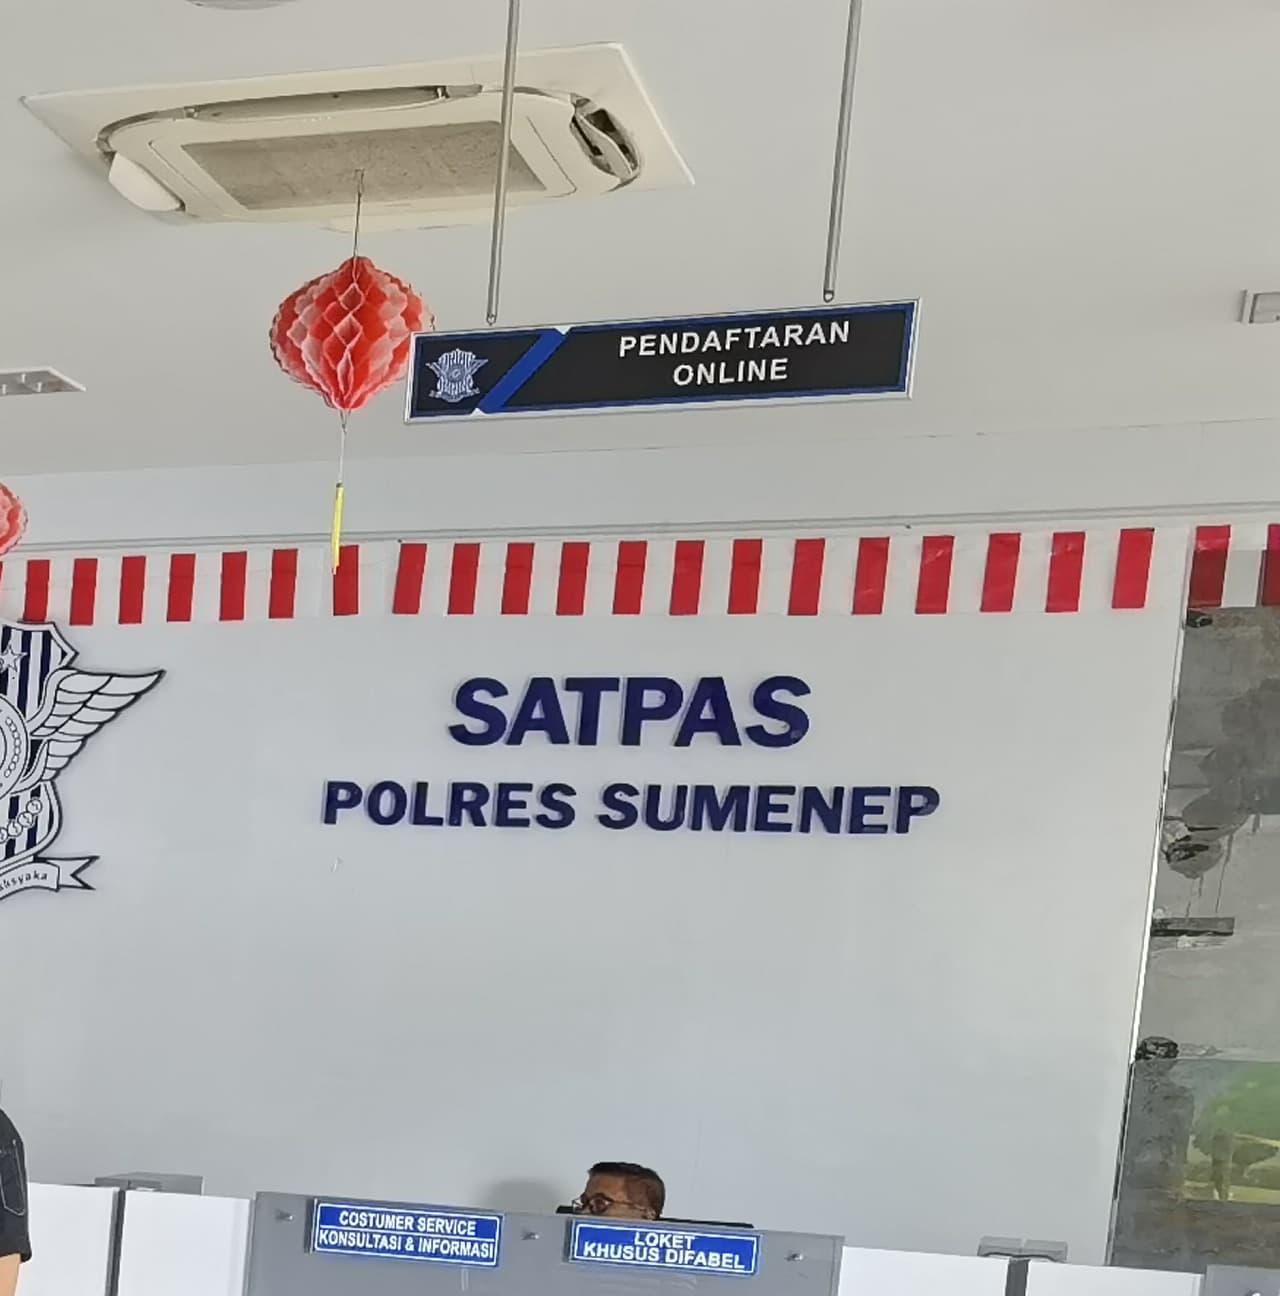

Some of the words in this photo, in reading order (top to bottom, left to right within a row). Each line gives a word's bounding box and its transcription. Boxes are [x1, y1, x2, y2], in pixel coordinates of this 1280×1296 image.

[618, 320, 851, 358] PENDAFTARAN
[672, 358, 789, 387] ONLINE
[448, 675, 812, 748] SATPAS
[322, 780, 577, 830] POLRES
[597, 782, 941, 835] SUMENEP
[340, 1210, 414, 1231] COSTUMER
[417, 1217, 477, 1236] SERVICE
[319, 1229, 401, 1250] KONSULTASI
[405, 1239, 415, 1252] &
[418, 1238, 494, 1258] INFORMASI
[634, 1231, 696, 1249] LOKET
[583, 1241, 660, 1262] KHUSUS
[665, 1250, 745, 1269] DIFABEL
